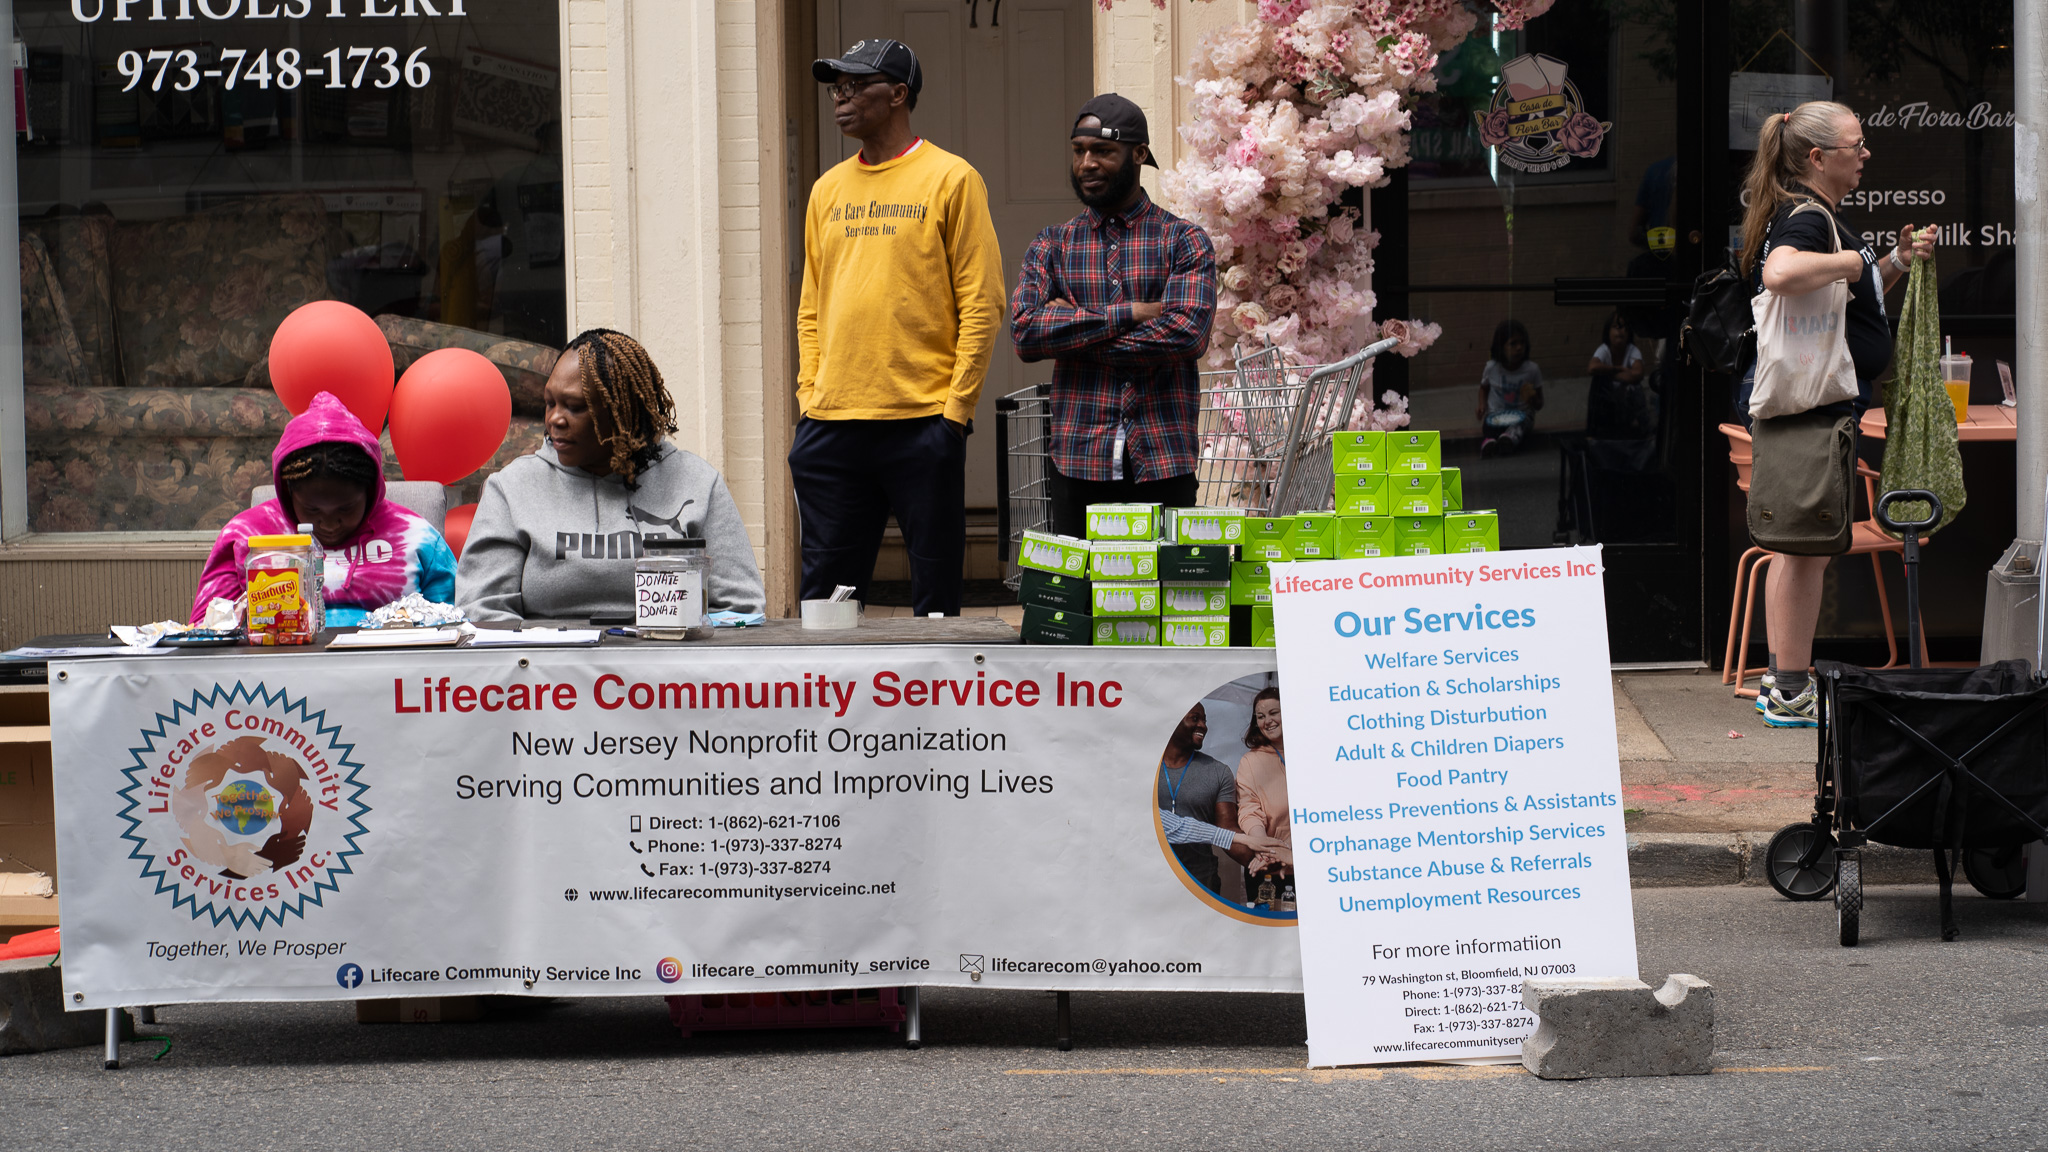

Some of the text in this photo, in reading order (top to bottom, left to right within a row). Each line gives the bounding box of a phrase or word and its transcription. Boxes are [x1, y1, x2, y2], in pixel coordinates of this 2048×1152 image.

[117, 46, 431, 92] 973-748-1736
[1519, 98, 1554, 112] Casa de
[1868, 105, 1897, 127] de
[1898, 102, 1965, 130] Flora
[1966, 101, 2015, 130] Bar
[1515, 119, 1560, 135] Flora Bar
[1528, 163, 1540, 172] THE
[1841, 189, 1946, 212] Espresso
[845, 202, 866, 221] Care
[868, 200, 928, 224] Community
[882, 223, 897, 235] Inc
[556, 530, 668, 560] PUM
[636, 573, 679, 587] DONATE
[1275, 560, 1596, 593] Lifecare Community Services Inc
[250, 580, 296, 603] Starburst
[639, 589, 688, 603] DONATE
[639, 604, 678, 618] DONATE
[1334, 603, 1535, 638] Our Services
[1365, 647, 1519, 669] Welfare Services
[394, 671, 1122, 717] Lifecare Community Service Inc
[1329, 674, 1560, 701] Education & Scholarships
[1347, 705, 1546, 730] Clothing Disturbution
[513, 727, 1006, 760] New Jersey Nonprofit Organization
[1335, 736, 1564, 761] Adult & Children Diapers
[148, 709, 341, 813] Lifecare Community
[456, 768, 1053, 805] Serving Communities and Improving Lives
[1397, 769, 1508, 788] Food Pantry
[211, 789, 276, 804] Together
[210, 805, 282, 820] We Prosper
[1293, 792, 1616, 824] Homeless Preventions & Assistants
[650, 815, 840, 832] Direct: 1-(862)-621-7106
[648, 837, 842, 855] Phone: 1-(973)-337-8274
[1310, 822, 1605, 855] Orphanage Mentorship Services
[167, 848, 332, 901] Services Inc.
[660, 861, 831, 878] Fax: 1-(973)-337-8274
[1328, 852, 1592, 883] Substance Abuse & Referrals
[589, 881, 896, 901] www.lifecarecommunityserviceinc.net
[1340, 887, 1580, 913] Unemployment Resources
[146, 940, 347, 961] Together, We Prosper
[1373, 944, 1400, 960] For
[1406, 945, 1450, 958] more
[371, 966, 641, 984] Lifecare Community Service Inc
[693, 956, 930, 978] lifecare_community_service
[992, 958, 1201, 976] lifecarecom@yahoo.com
[1362, 964, 1575, 986] 79 Washington st, Bloomfield, NJ 07003
[1403, 984, 1523, 1000] Phone: 1-(973)-337-82
[1405, 1001, 1526, 1017] Direct: 1-(862)-621-71
[1414, 1017, 1534, 1033] Fax: 1-(973)-337-8274
